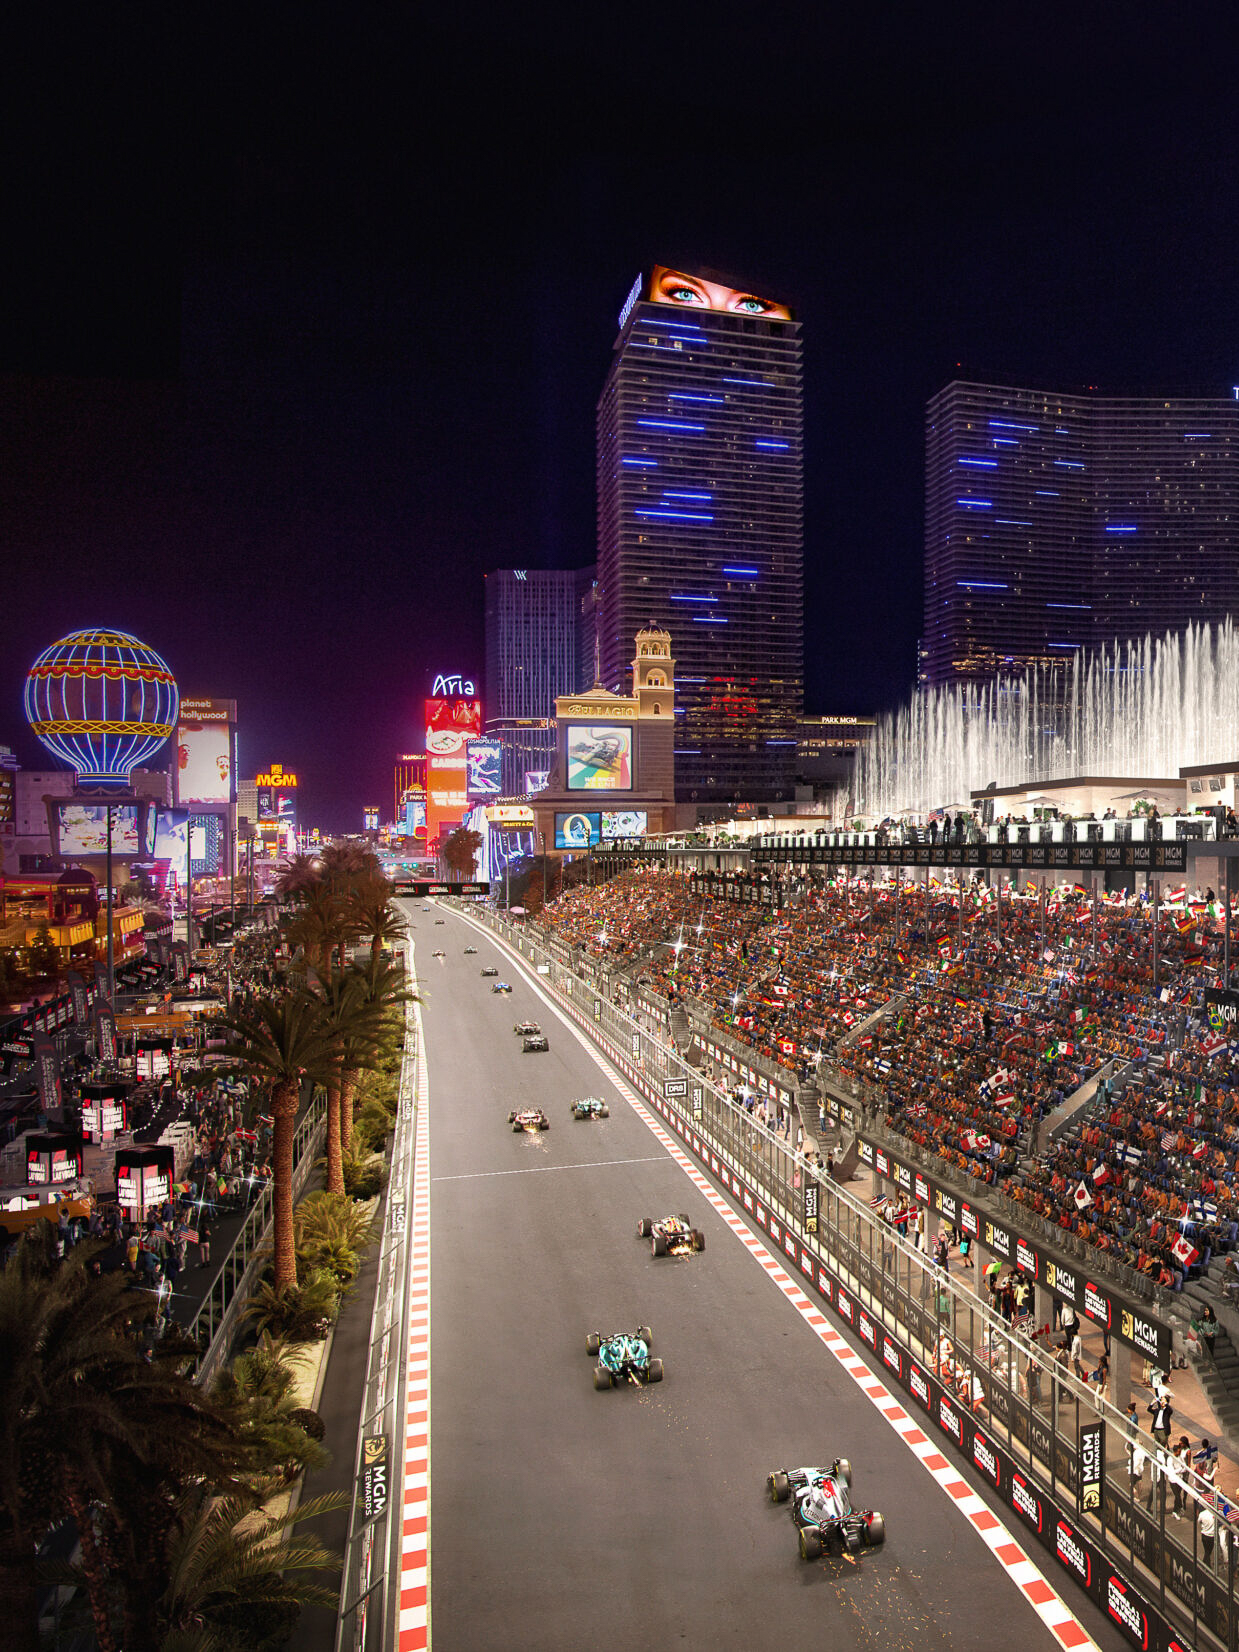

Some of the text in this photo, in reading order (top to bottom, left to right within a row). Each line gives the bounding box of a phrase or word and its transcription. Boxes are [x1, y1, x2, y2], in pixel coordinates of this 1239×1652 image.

[432, 674, 475, 696] Aria
[180, 700, 211, 709] planet
[568, 704, 634, 716] BELLAGIO
[180, 710, 227, 720] hollywood
[821, 716, 839, 724] PARK
[256, 774, 298, 787] MGM
[1080, 848, 1093, 858] MGM
[1106, 848, 1120, 858] MGM
[1134, 848, 1150, 858] MGM
[1165, 848, 1182, 858] MGM
[1218, 1004, 1237, 1022] MGM
[942, 1194, 956, 1213] MGM
[994, 1226, 1010, 1248] MGM
[1056, 1266, 1075, 1291] MGM
[1134, 1317, 1158, 1346] MGM
[1134, 1335, 1159, 1358] REWARDS
[1083, 1433, 1094, 1482] MGM
[373, 1465, 387, 1514] MGM
